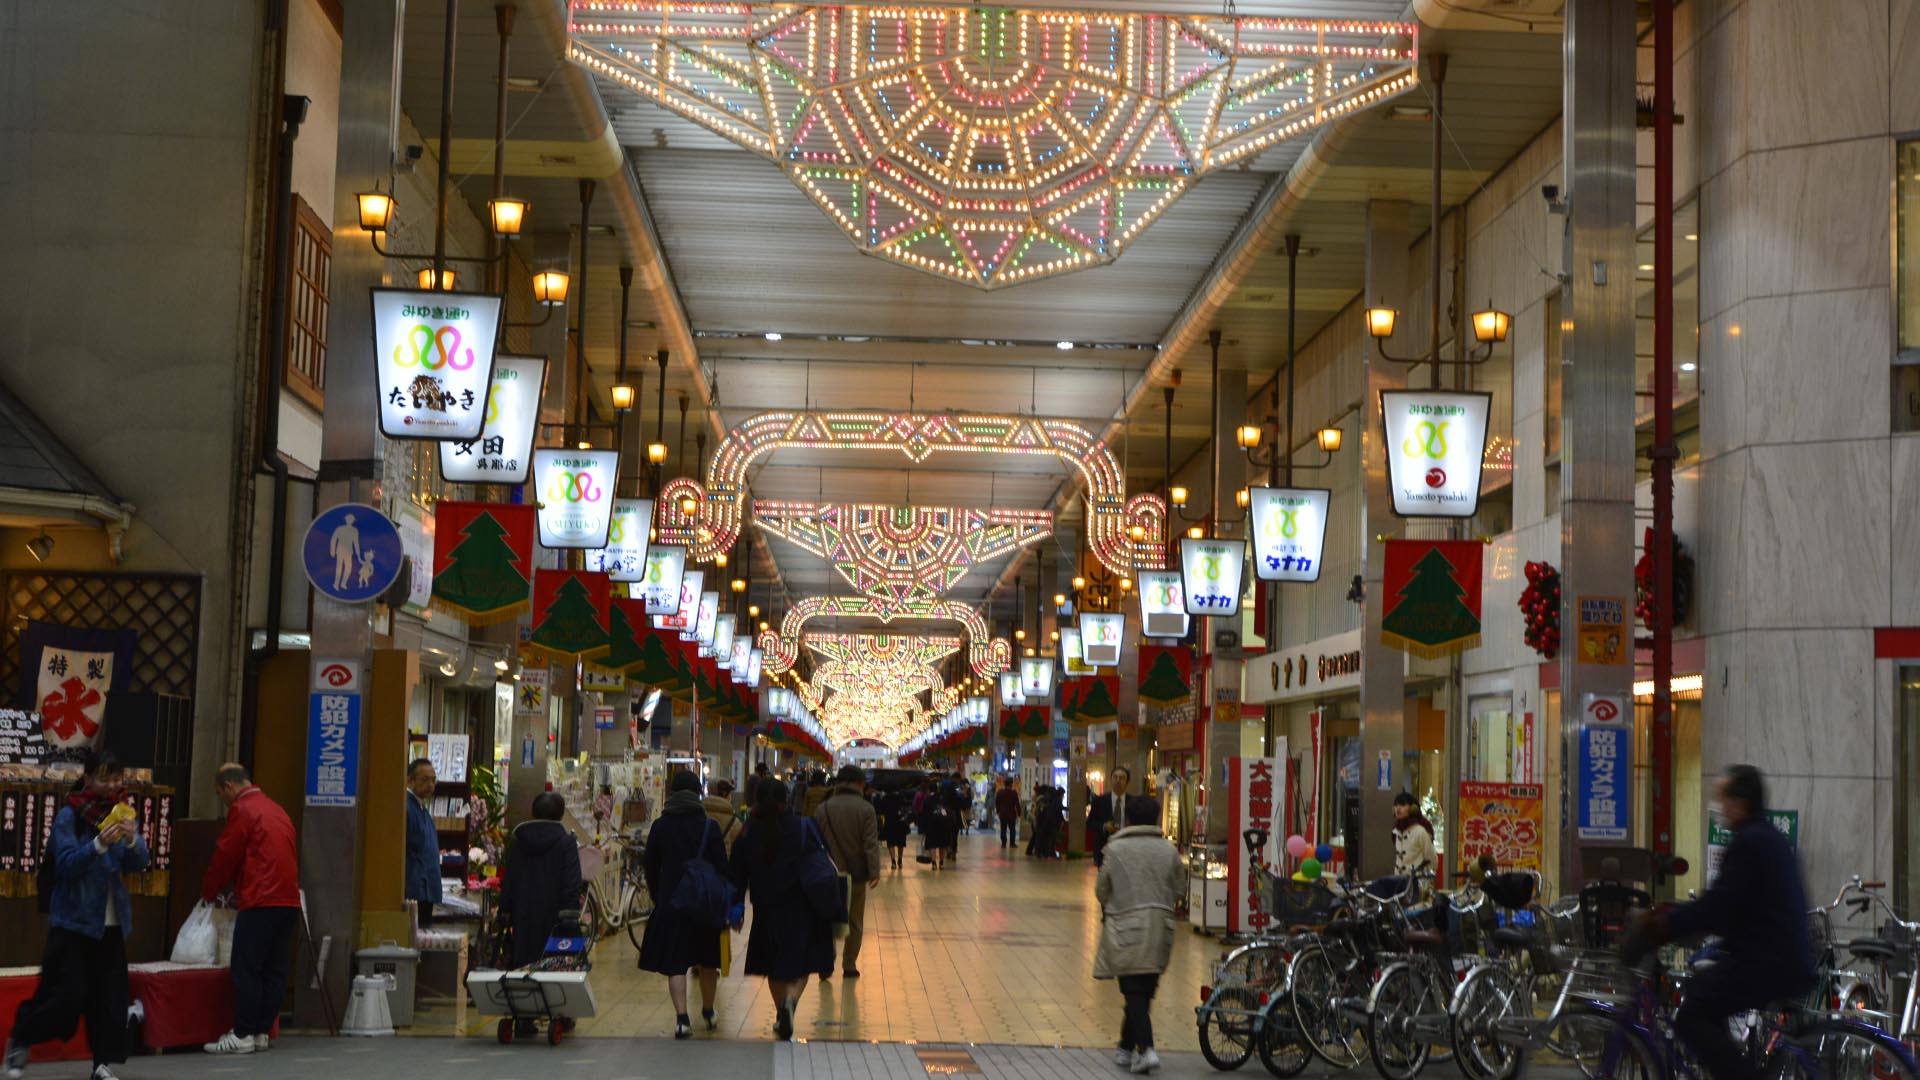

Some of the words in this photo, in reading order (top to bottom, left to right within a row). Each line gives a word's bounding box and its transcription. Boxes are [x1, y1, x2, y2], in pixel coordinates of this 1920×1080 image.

[402, 305, 470, 320] みゆき通り
[1409, 404, 1466, 416] みゆき通り
[1266, 555, 1312, 572] タナカ
[1194, 594, 1231, 608] タナカ
[48, 654, 104, 680] 特製
[317, 695, 350, 795] 防犯カメラ設置
[1588, 729, 1617, 827] 防犯カメラ設置
[1465, 818, 1536, 844] まぐろ
